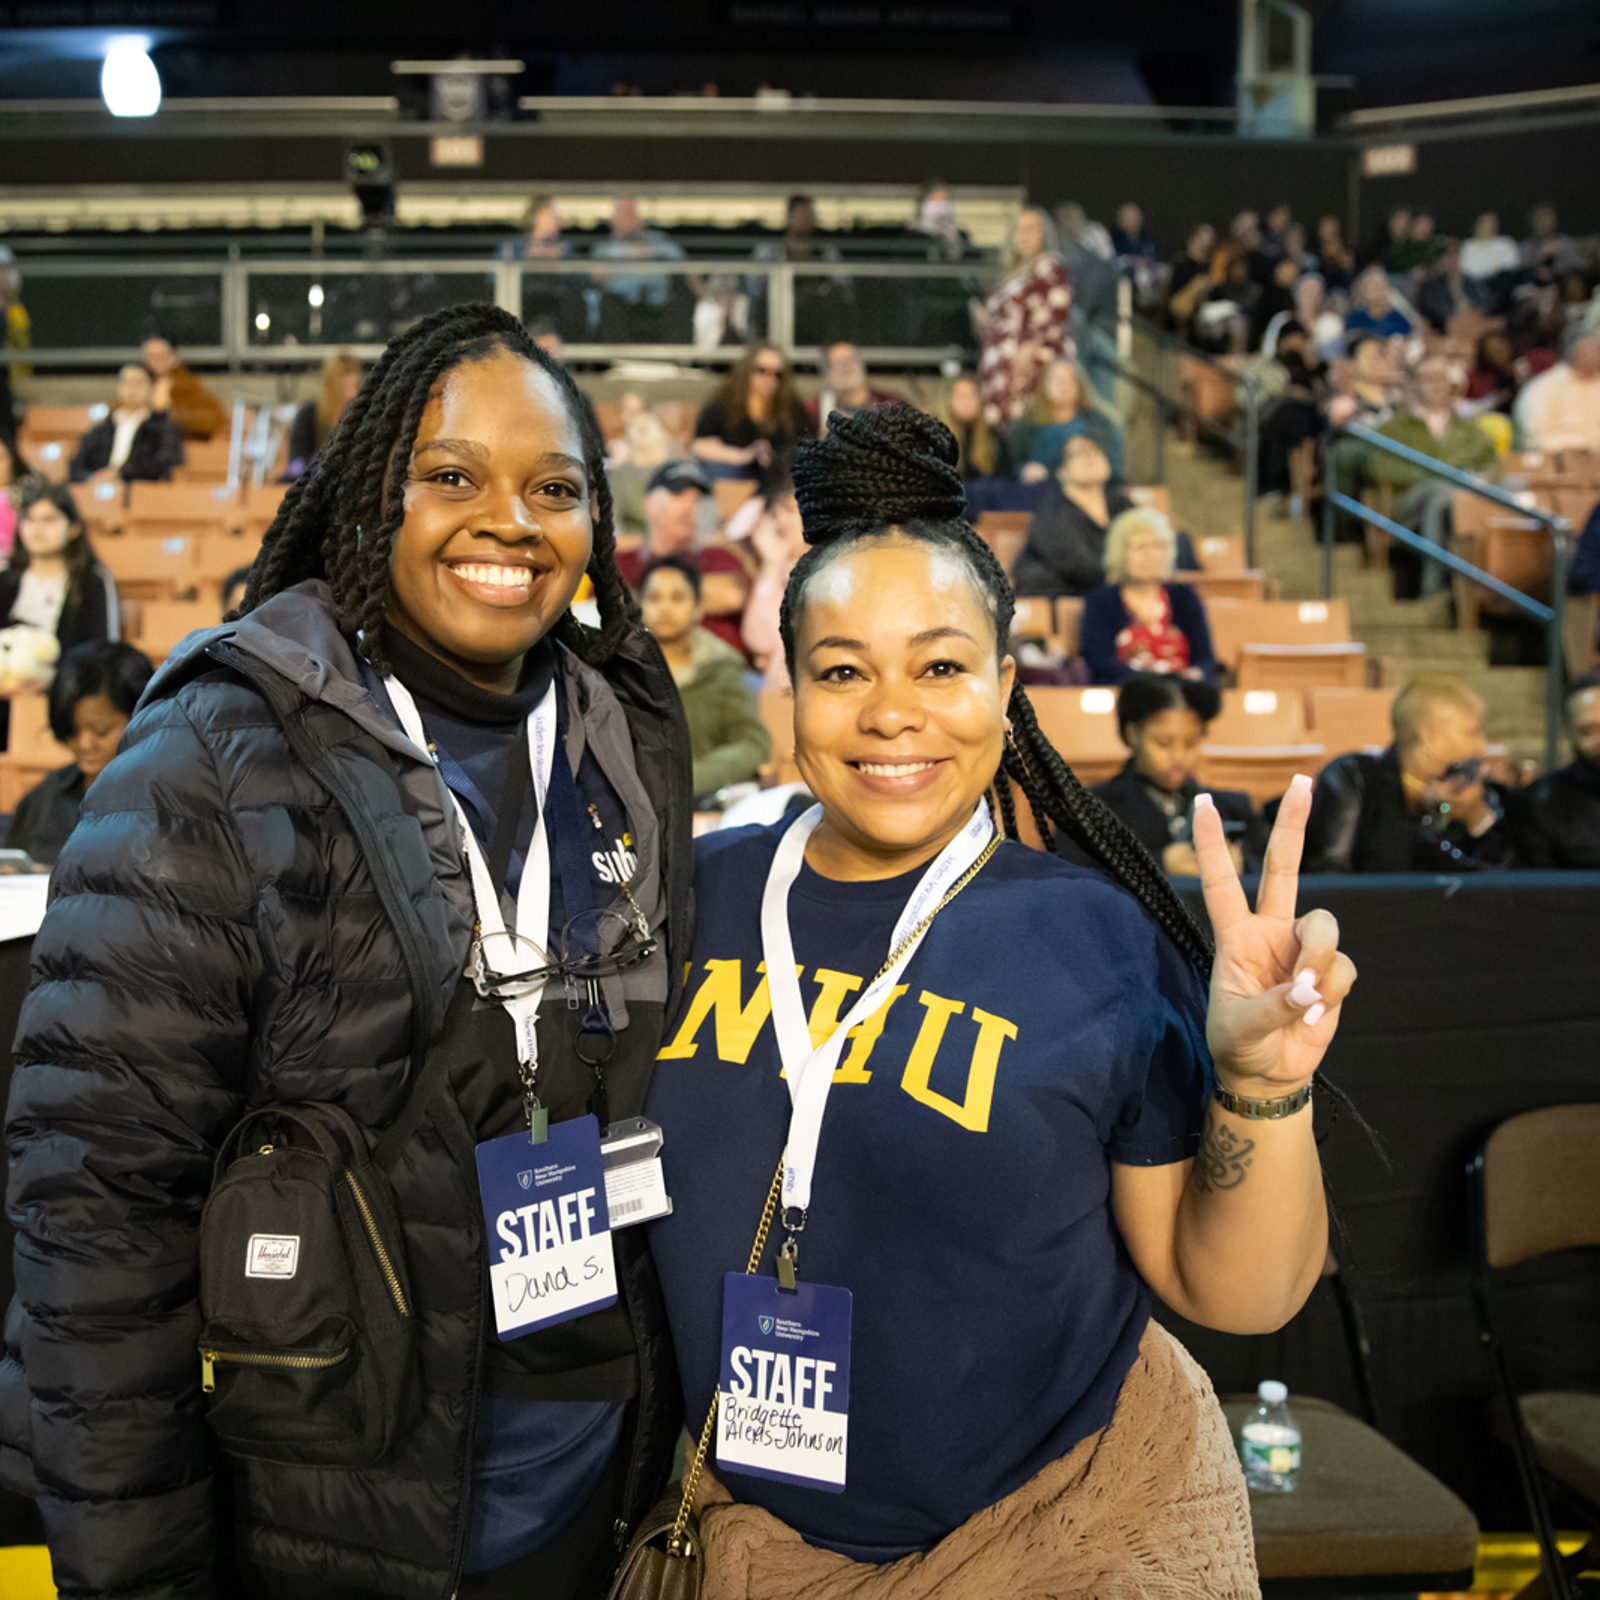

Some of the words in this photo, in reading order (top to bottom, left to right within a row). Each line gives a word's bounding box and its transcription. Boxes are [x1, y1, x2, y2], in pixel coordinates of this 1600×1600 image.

[592, 839, 638, 883] snh
[656, 958, 1019, 1133] NHU
[534, 1164, 558, 1174] Southern
[535, 1173, 548, 1181] New
[548, 1165, 576, 1176] Hampshire
[535, 1175, 562, 1187] University
[496, 1187, 595, 1264] STAFF
[776, 1318, 801, 1327] Southern
[775, 1331, 804, 1342] University
[790, 1327, 820, 1337] Hampshire
[729, 1346, 836, 1411] STAFF
[724, 1396, 803, 1428] Bridgette
